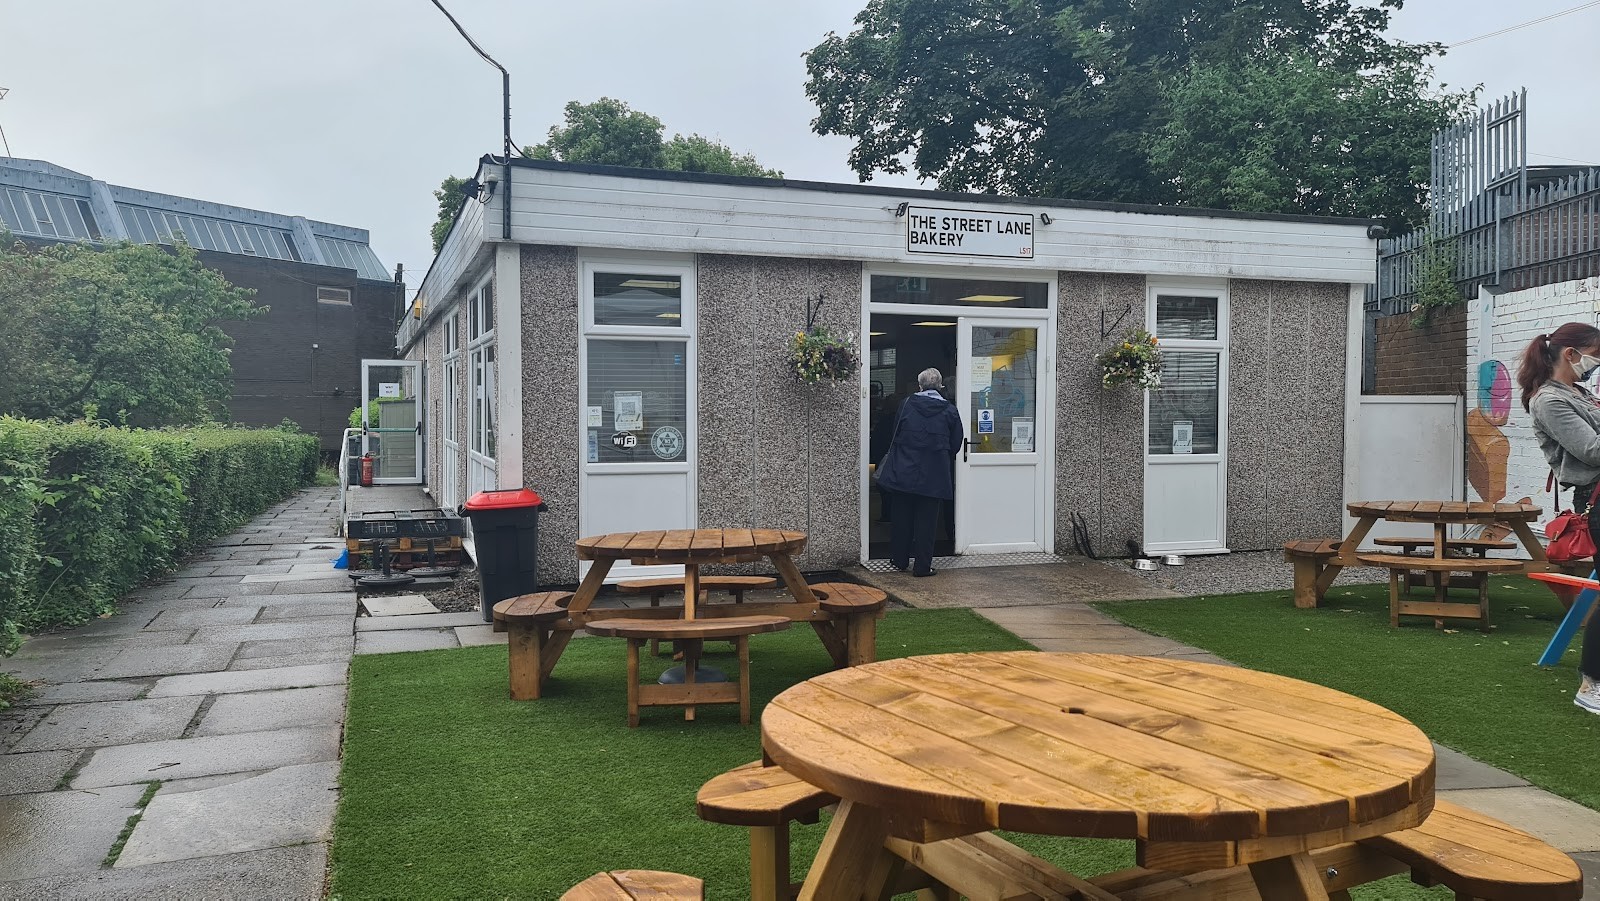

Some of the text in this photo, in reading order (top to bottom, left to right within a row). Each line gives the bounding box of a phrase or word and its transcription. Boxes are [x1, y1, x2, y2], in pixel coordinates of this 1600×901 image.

[911, 215, 1031, 235] THE STREET LANE
[910, 231, 964, 246] BAKERY
[1020, 247, 1031, 255] LS17
